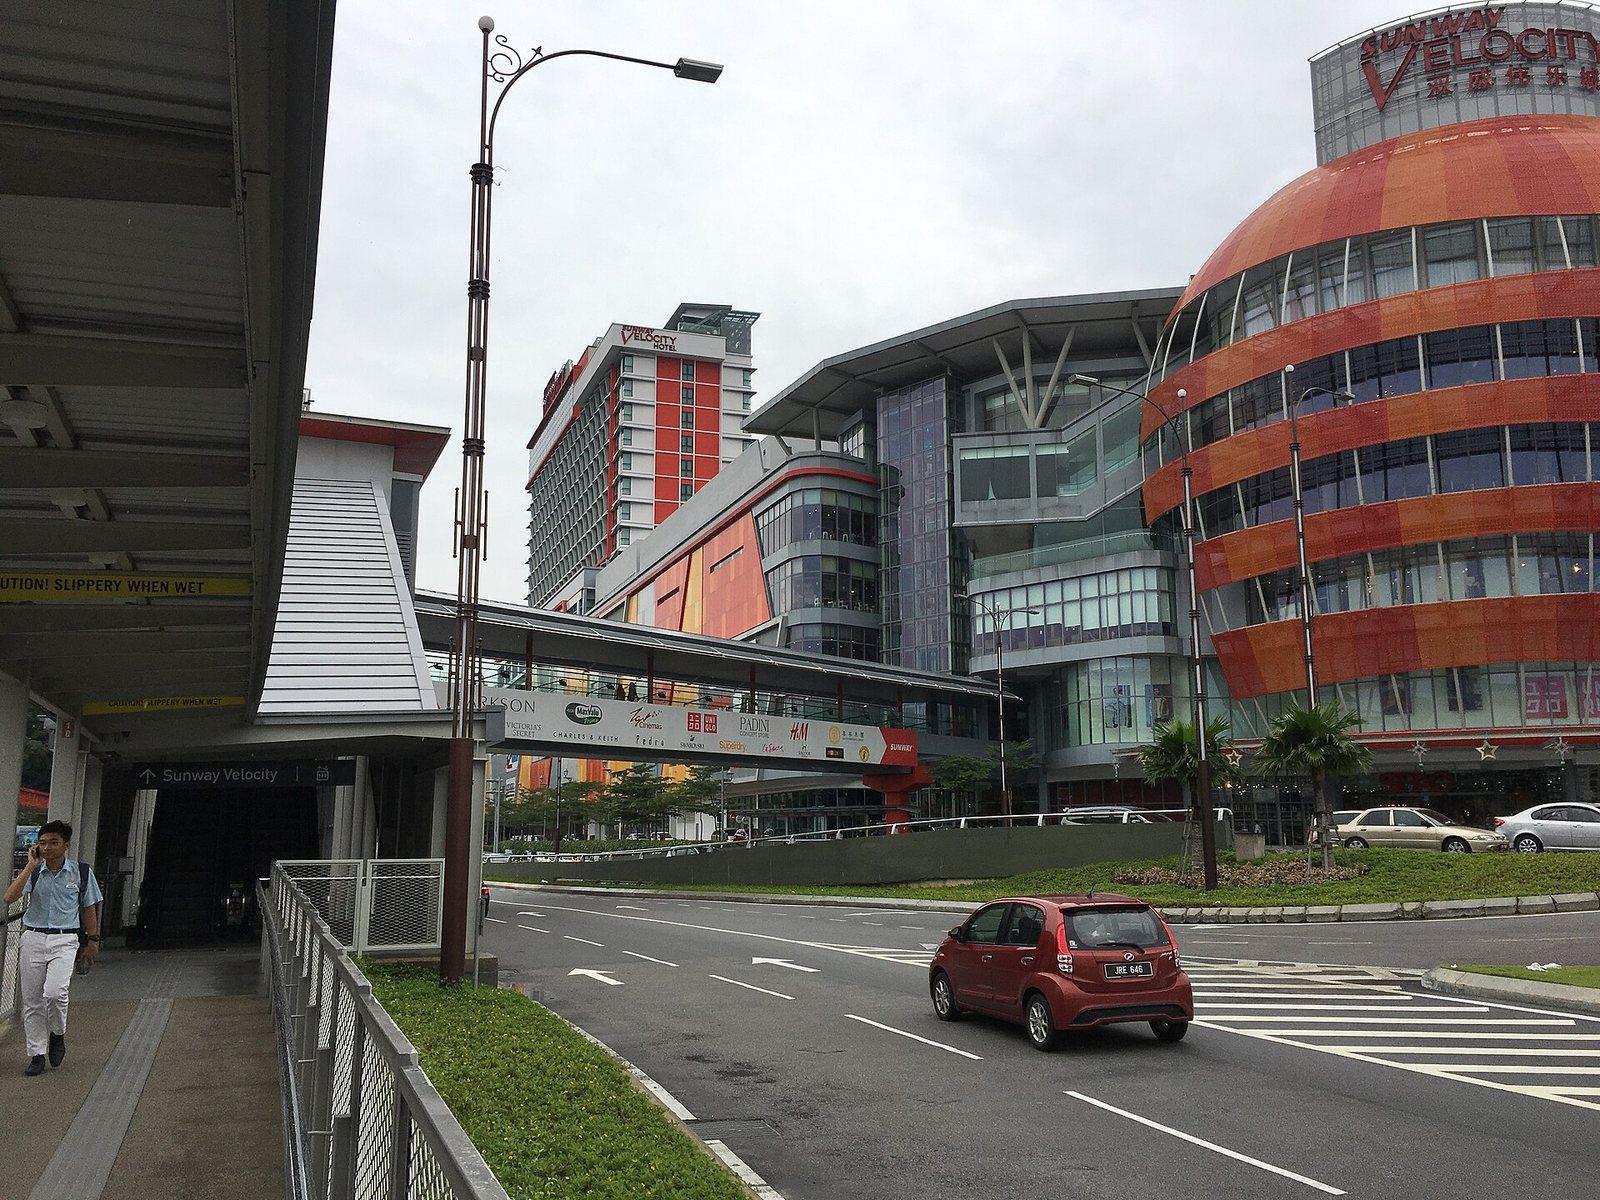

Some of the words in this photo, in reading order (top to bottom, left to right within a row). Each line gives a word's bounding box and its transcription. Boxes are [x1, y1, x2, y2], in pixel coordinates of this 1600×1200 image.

[1360, 7, 1506, 61] SUNWAY
[621, 324, 656, 335] SUNWAY
[621, 330, 678, 345] VELOCITY
[653, 343, 678, 351] HOTEL
[54, 578, 122, 593] SLIPPERY
[127, 580, 169, 594] WHEN
[174, 581, 205, 594] WET
[108, 699, 144, 707] CAUTION!
[146, 699, 181, 707] SLIPPERY
[182, 698, 205, 706] WHEN
[206, 697, 222, 705] WET
[506, 721, 542, 731] VICTORIA'S
[639, 721, 663, 730] Cinemas
[740, 716, 770, 732] PADINI
[513, 729, 536, 738] SECRET
[552, 731, 586, 740] CHARLES
[598, 734, 620, 742] KEITH
[789, 721, 809, 741] H&M
[890, 743, 913, 752] SUNWAY
[163, 769, 220, 784] Sunway
[223, 768, 278, 783] Velocity
[1114, 965, 1128, 975] JRE
[1130, 964, 1143, 974] 646
